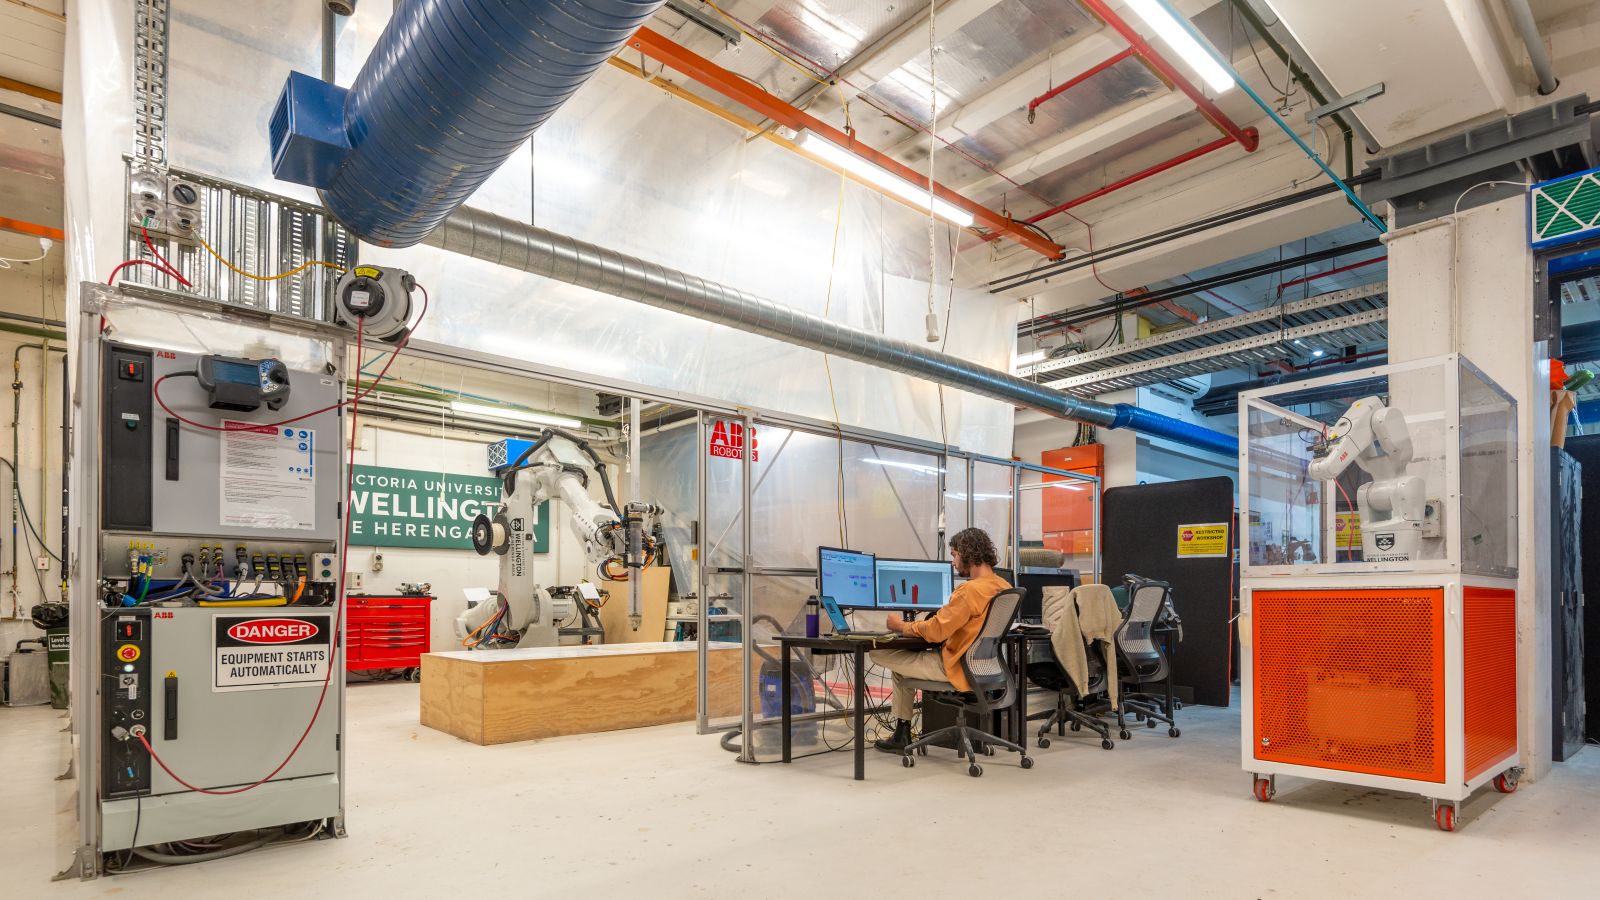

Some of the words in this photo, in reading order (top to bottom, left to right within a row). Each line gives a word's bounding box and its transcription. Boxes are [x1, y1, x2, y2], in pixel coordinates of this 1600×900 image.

[156, 351, 176, 360] ABB
[713, 446, 756, 461] ROBOTS
[352, 473, 418, 491] ICTORIA
[424, 480, 503, 498] UNIVERSI
[346, 490, 539, 526] WELLINGT
[236, 624, 311, 639] DANGER
[221, 652, 284, 665] EQUIPMENT
[287, 650, 325, 663] STARTS
[230, 663, 317, 678] AUTOMATICALLY
